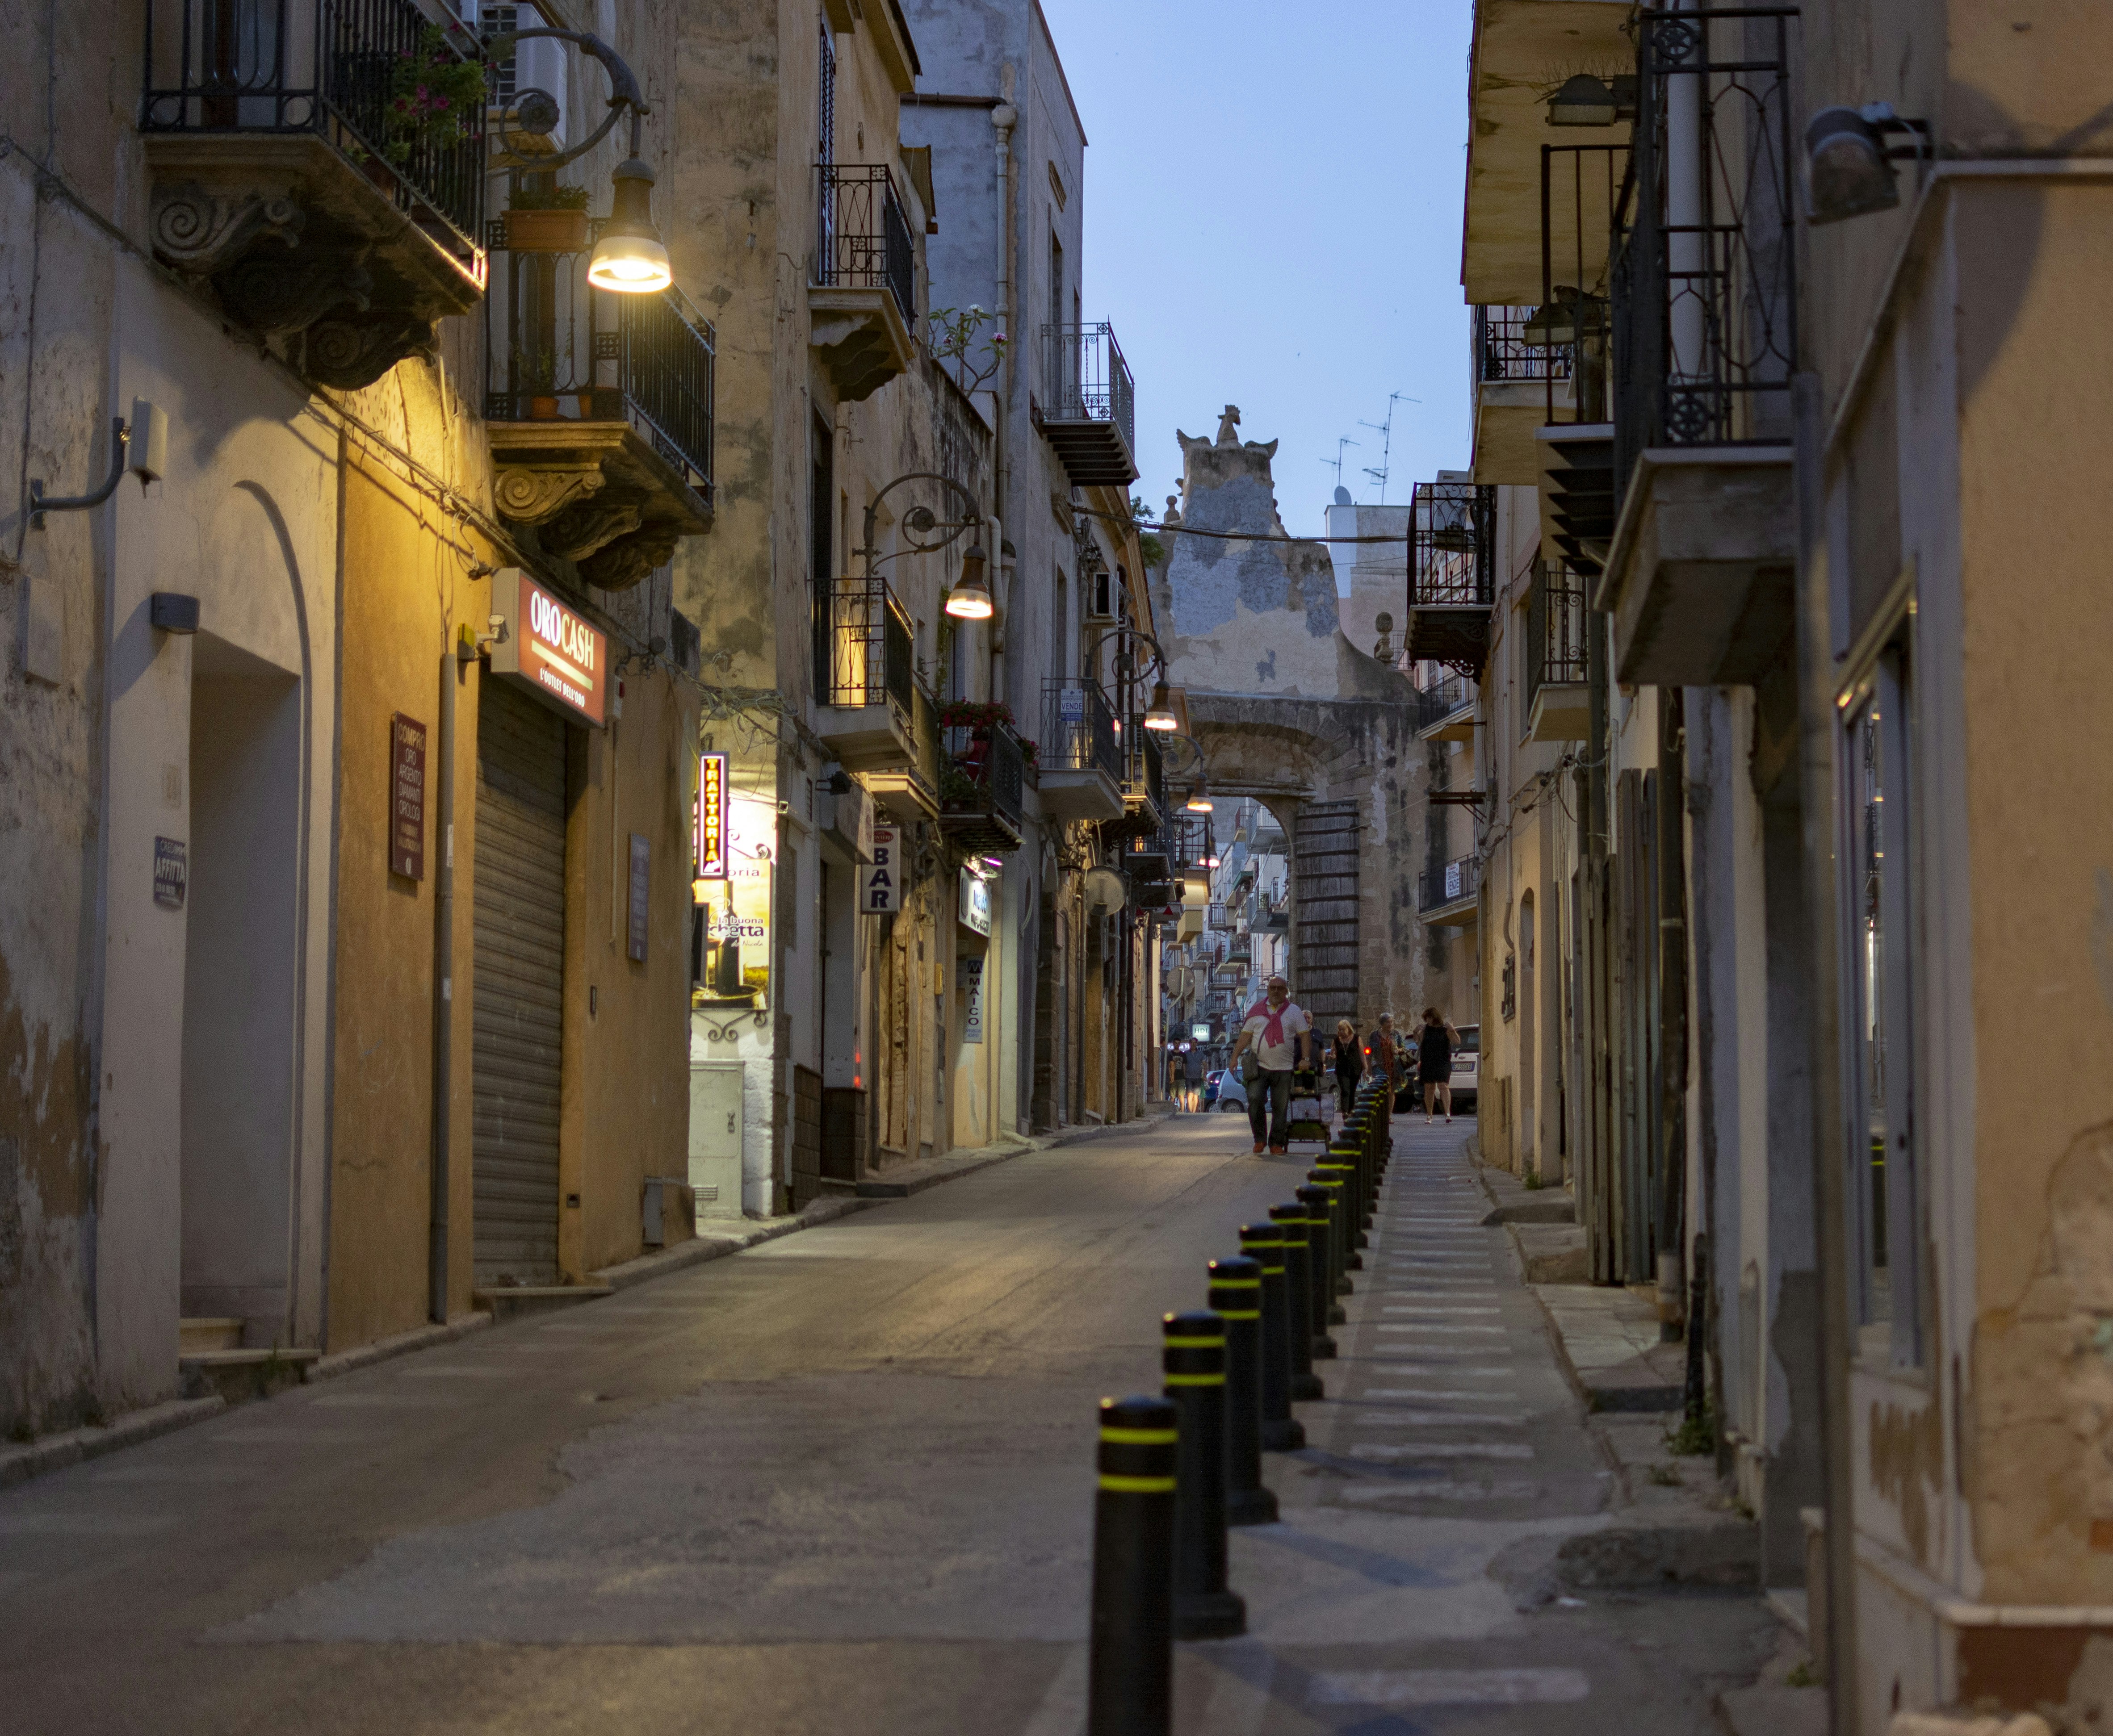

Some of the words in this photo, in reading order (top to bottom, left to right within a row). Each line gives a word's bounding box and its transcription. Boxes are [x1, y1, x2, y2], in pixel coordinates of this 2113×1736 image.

[539, 668, 562, 694] L'OUTLET
[563, 681, 585, 708] DELL'ORO
[398, 723, 425, 752] COMPRO
[405, 747, 416, 766] ORO
[399, 764, 422, 786] ARGENTO
[399, 782, 421, 803] DIAMANTI
[399, 799, 421, 821] OROLOGI
[705, 758, 719, 861] TRATTORIA
[155, 857, 185, 883] AFFITTA
[728, 868, 760, 876] oria
[868, 847, 891, 908] BAR
[709, 924, 763, 937] chetta
[968, 978, 980, 1025] MAICO
